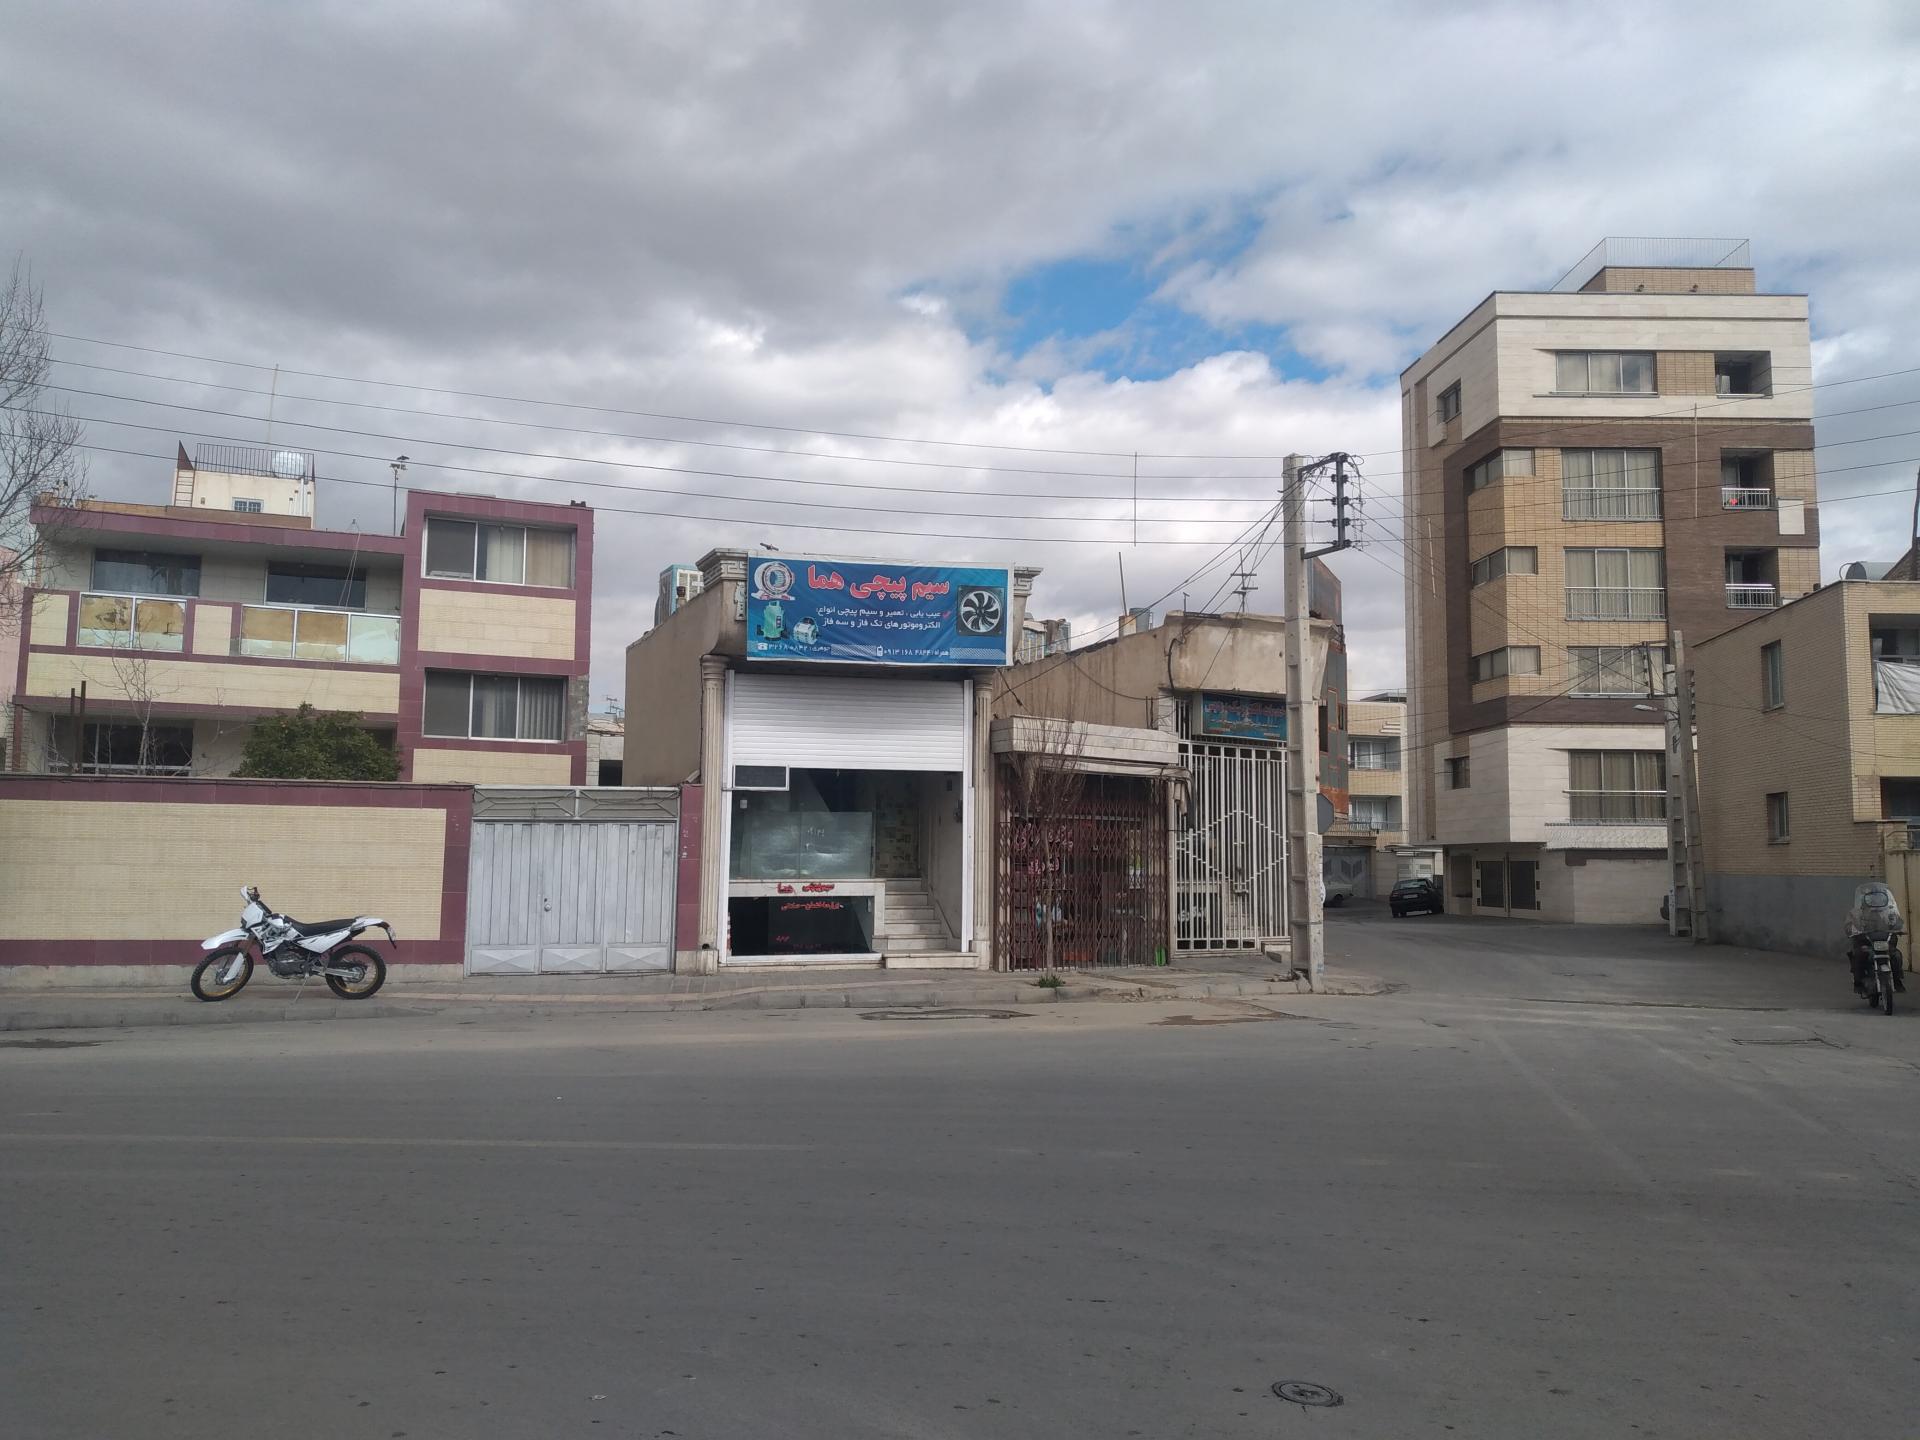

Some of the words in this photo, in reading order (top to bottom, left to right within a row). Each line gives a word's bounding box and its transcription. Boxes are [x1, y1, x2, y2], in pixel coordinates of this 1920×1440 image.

[808, 564, 844, 590] هما
[850, 575, 907, 601] پیچی
[912, 581, 949, 600] سیم
[837, 608, 857, 617] پیچی
[859, 608, 877, 616] سیم
[910, 610, 924, 619] یابی
[925, 611, 941, 619] عیب
[822, 618, 834, 627] فاز
[857, 619, 868, 628] فاز
[870, 619, 882, 627] تک
[884, 621, 941, 631] الکتروموتورهای
